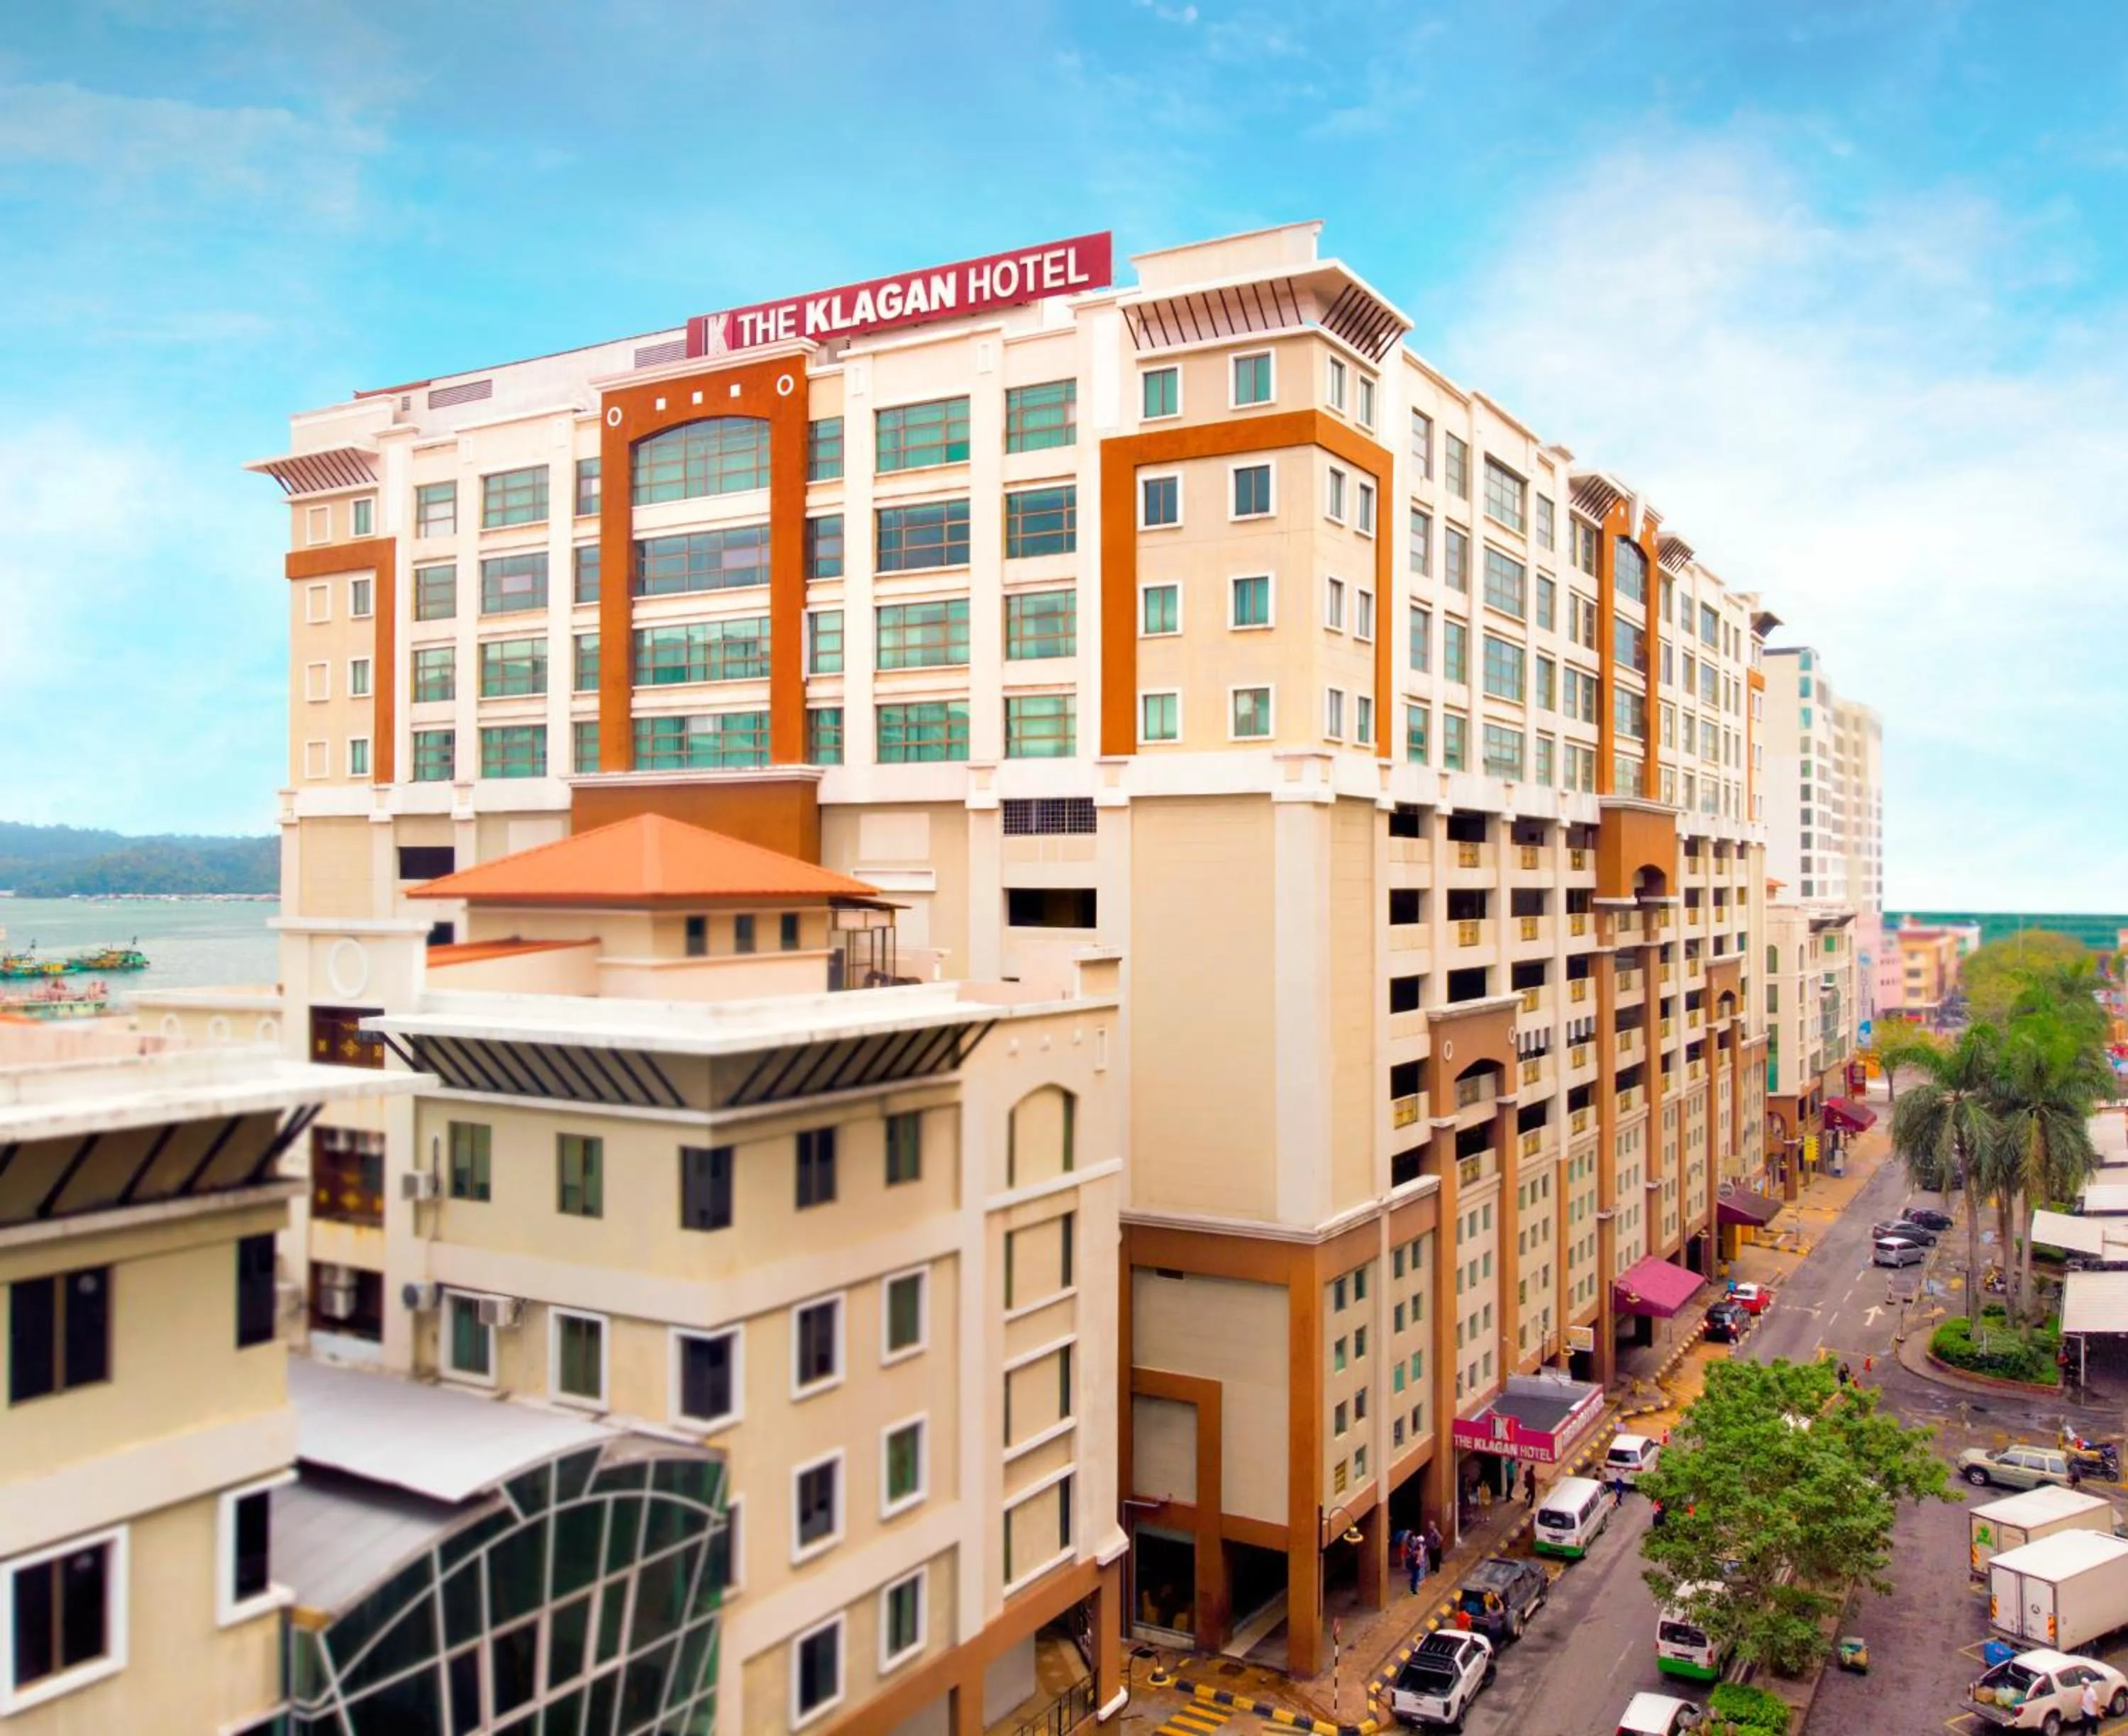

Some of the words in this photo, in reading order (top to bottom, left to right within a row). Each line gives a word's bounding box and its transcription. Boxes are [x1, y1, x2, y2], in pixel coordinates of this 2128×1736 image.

[737, 304, 797, 347] THE
[805, 270, 959, 335] KLAGAN
[968, 247, 1089, 304] HOTEL
[1455, 1435, 1473, 1448] THE
[1474, 1437, 1517, 1455] KLAGAN
[1520, 1445, 1553, 1462] HOTEL
